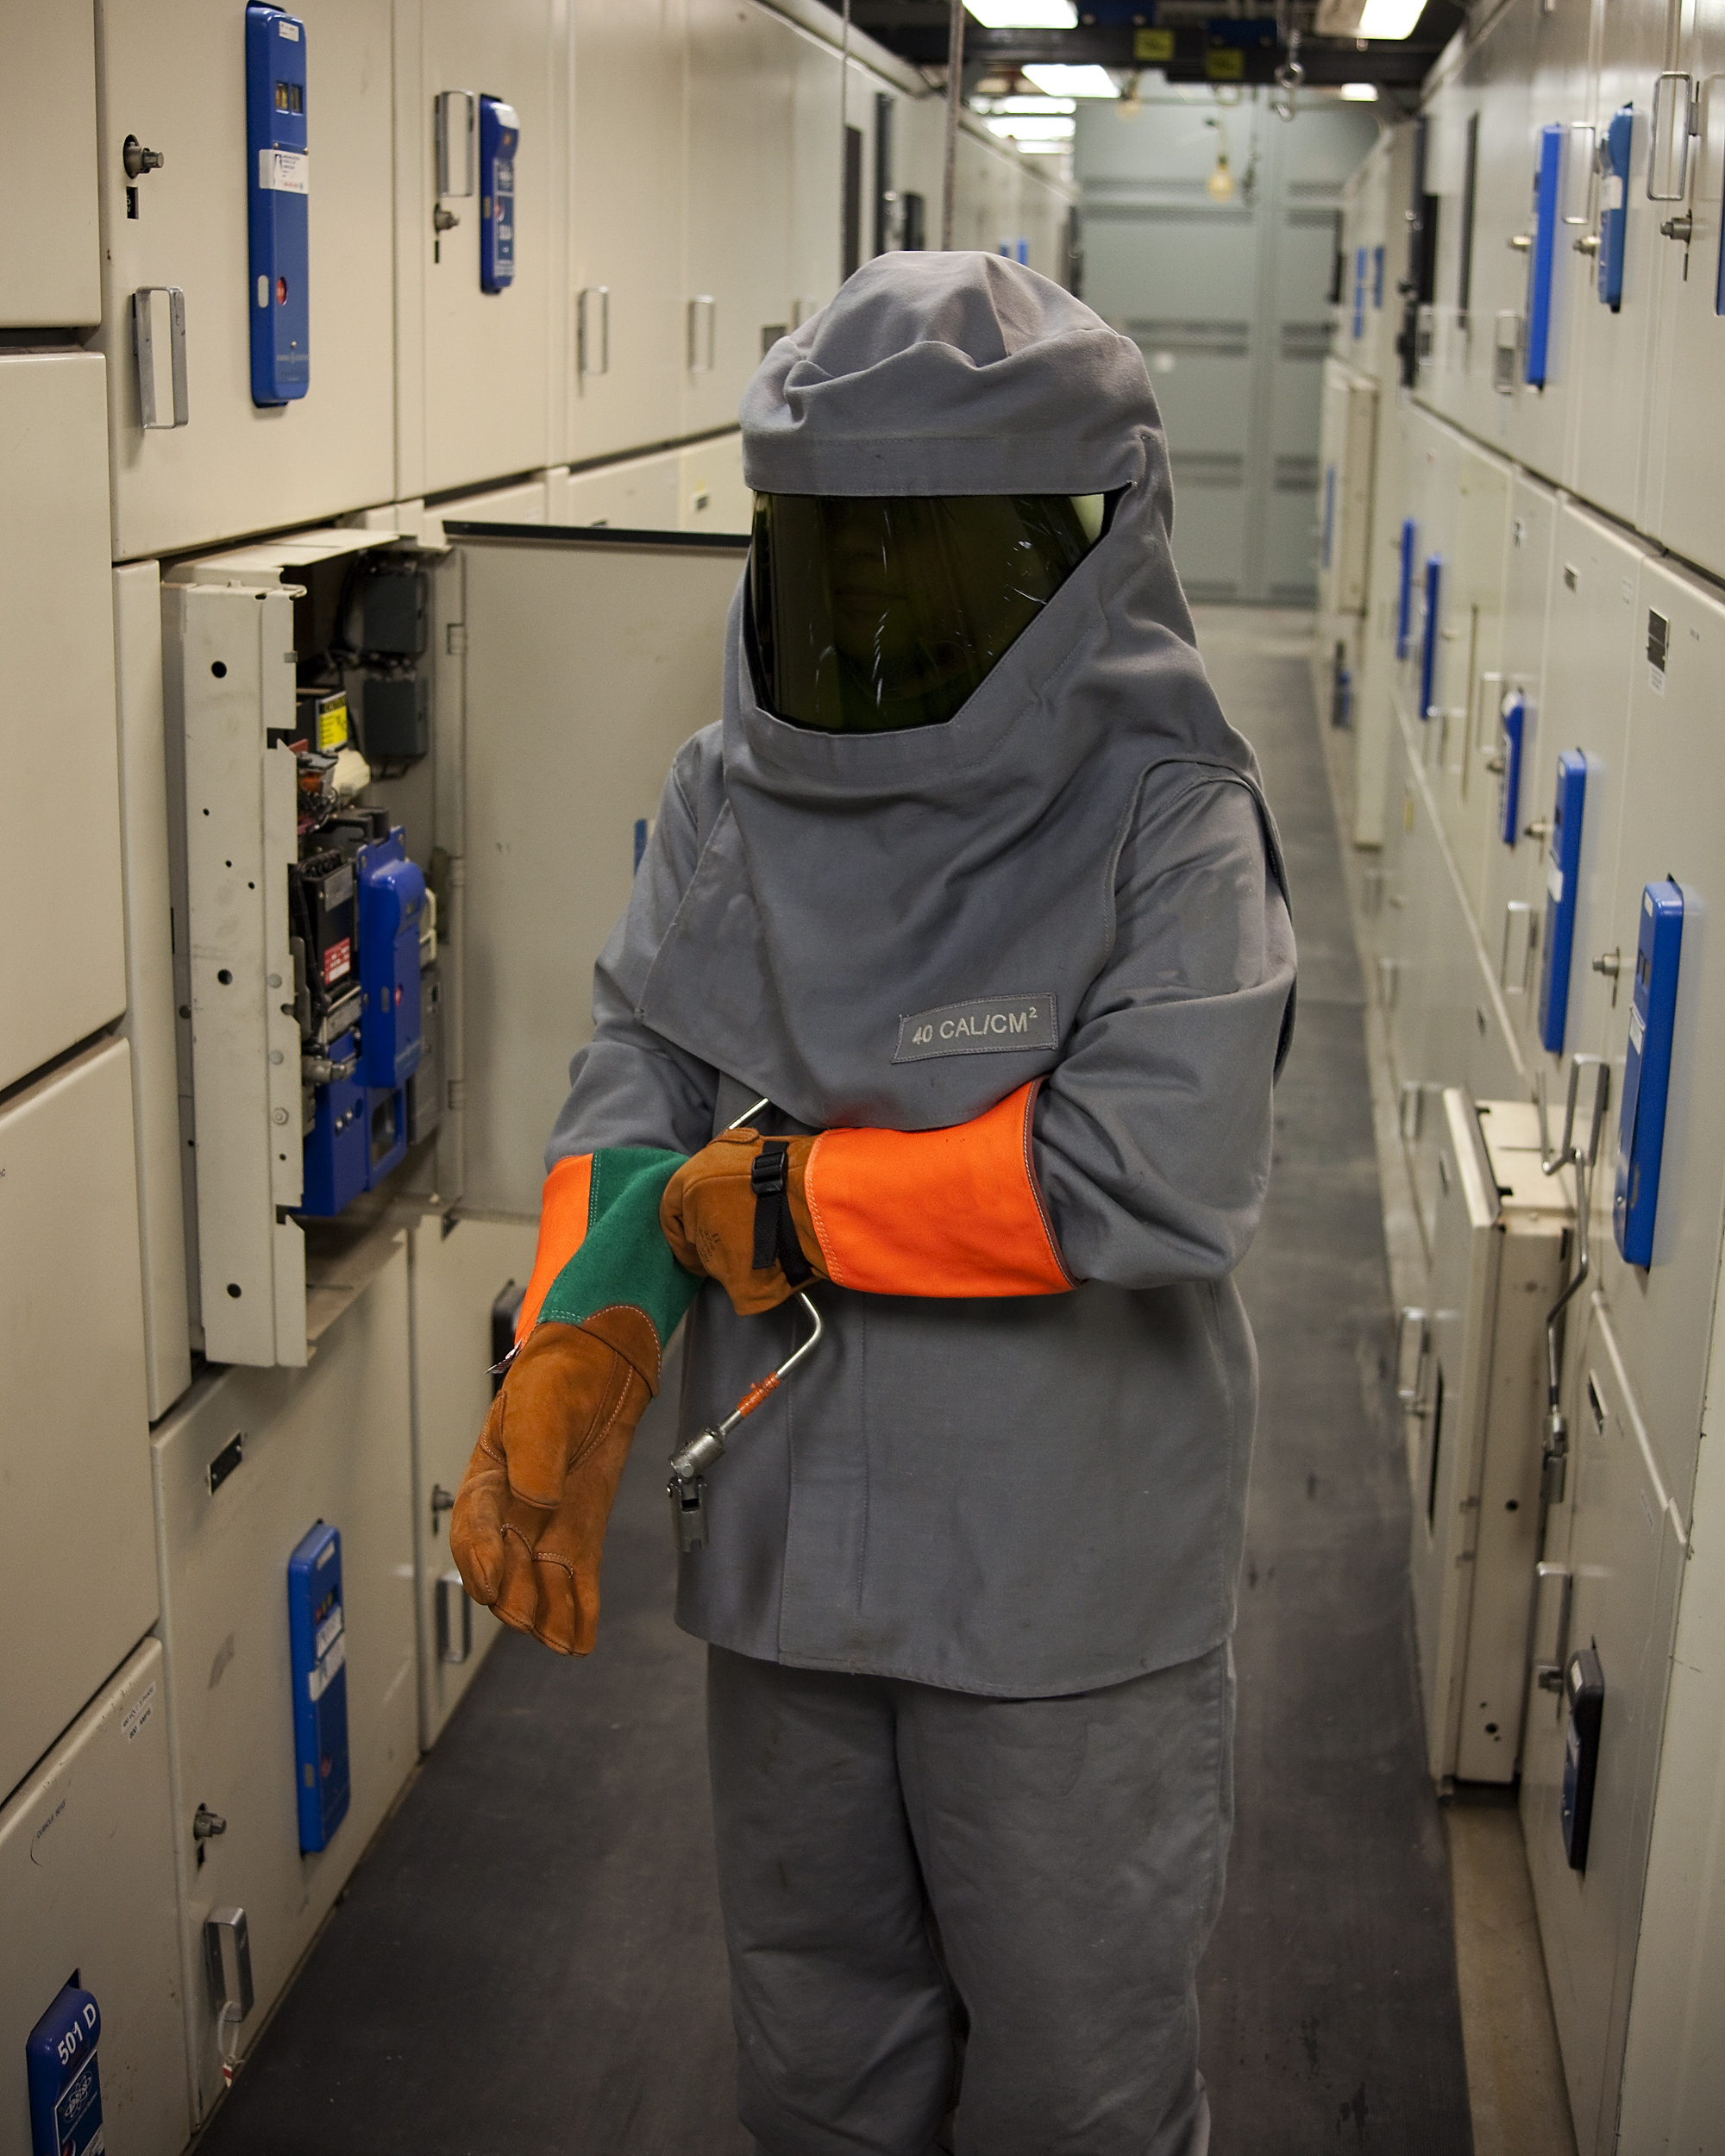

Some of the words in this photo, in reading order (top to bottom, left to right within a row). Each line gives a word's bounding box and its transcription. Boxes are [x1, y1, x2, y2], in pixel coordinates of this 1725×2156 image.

[912, 1024, 933, 1045] 40
[57, 2021, 84, 2065] 501
[83, 2002, 97, 2030] D
